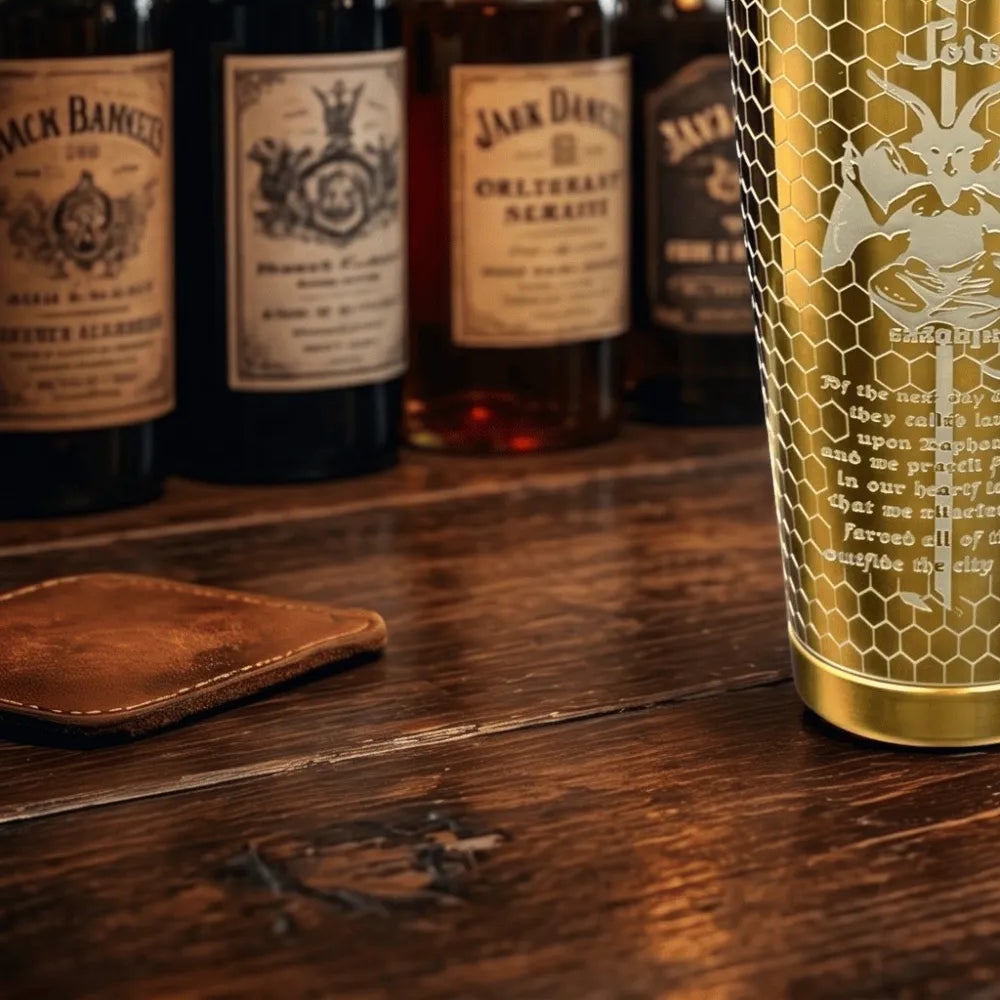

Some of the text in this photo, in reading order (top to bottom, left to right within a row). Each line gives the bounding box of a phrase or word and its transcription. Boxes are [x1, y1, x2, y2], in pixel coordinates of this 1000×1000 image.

[856, 384, 889, 401] the
[849, 405, 896, 428] they
[856, 433, 912, 450] upon
[821, 446, 862, 465] and
[866, 480, 906, 495] our
[827, 493, 875, 515] that
[912, 557, 945, 576] the
[953, 555, 994, 577] city
